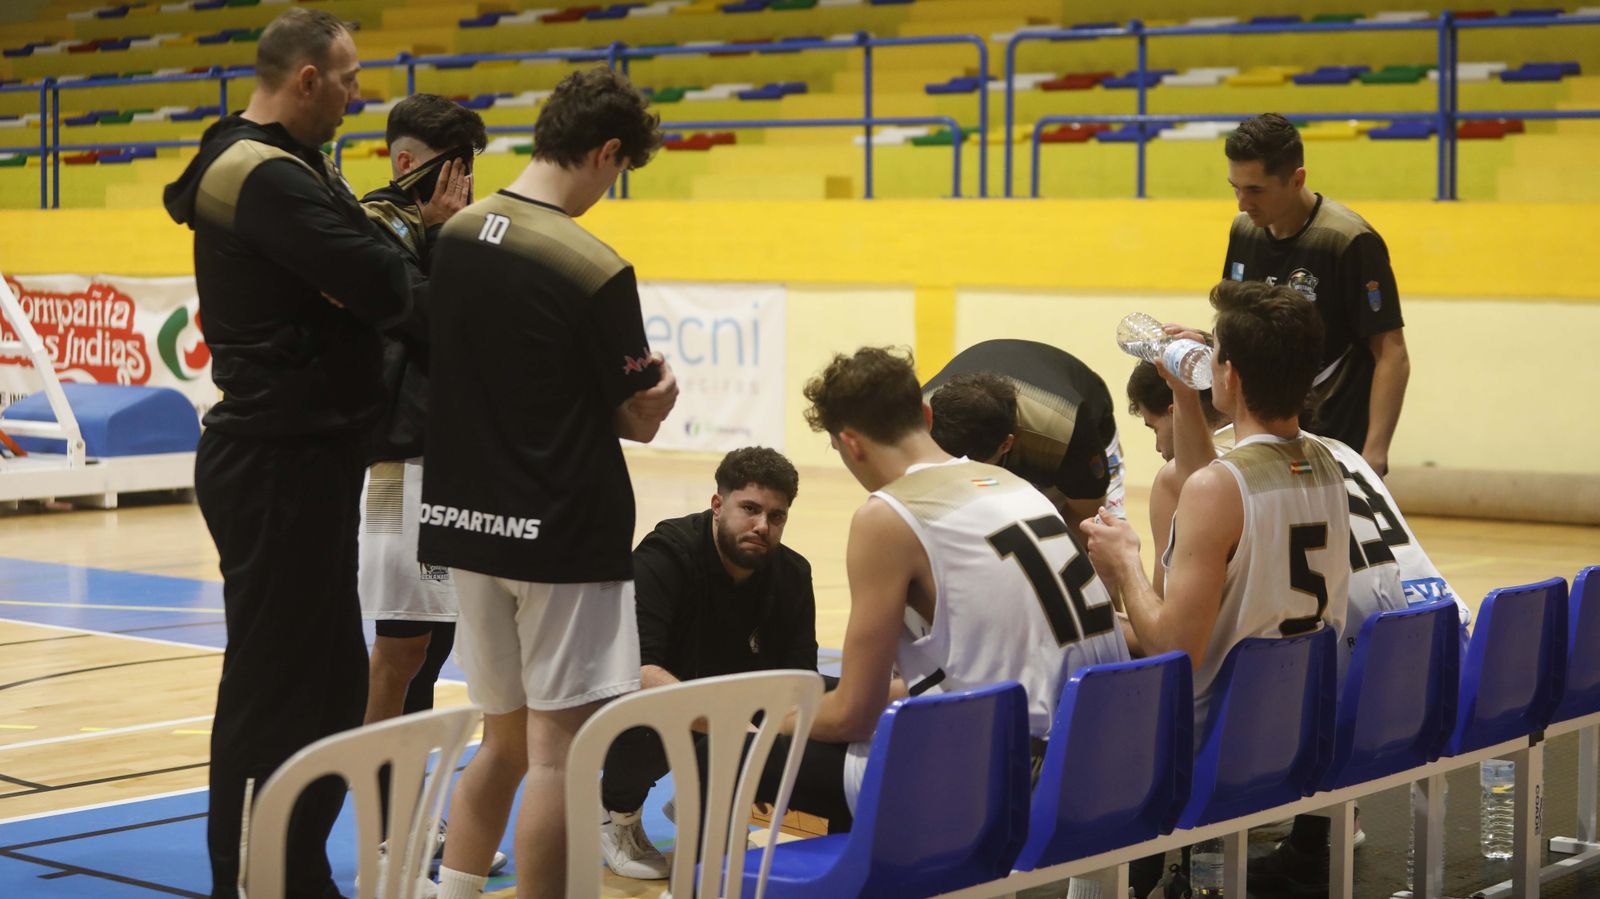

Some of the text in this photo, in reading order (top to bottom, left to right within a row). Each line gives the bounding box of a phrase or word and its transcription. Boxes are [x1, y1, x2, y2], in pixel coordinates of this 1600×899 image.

[478, 213, 511, 245] 10
[984, 513, 1115, 648] 12
[1278, 521, 1329, 638] 5
